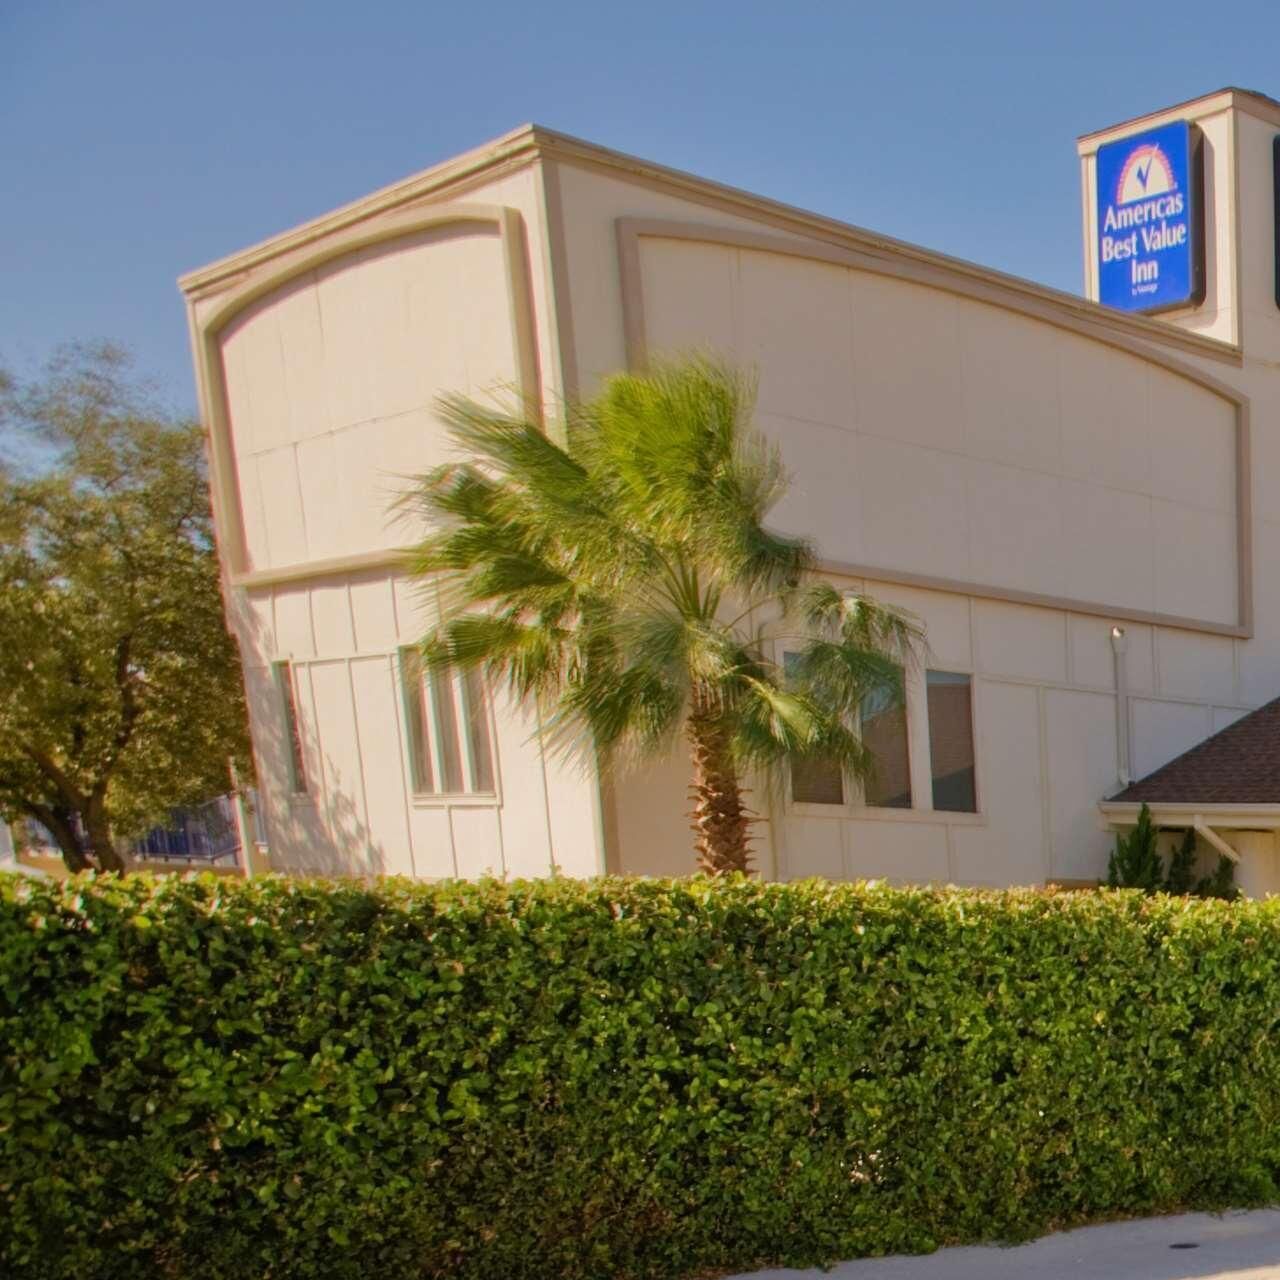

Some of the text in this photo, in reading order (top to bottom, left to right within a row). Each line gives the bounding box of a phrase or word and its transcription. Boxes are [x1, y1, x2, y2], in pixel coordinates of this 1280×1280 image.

[1104, 193, 1183, 232] Americas
[1102, 220, 1187, 263] Best Value
[1131, 259, 1158, 285] Inn
